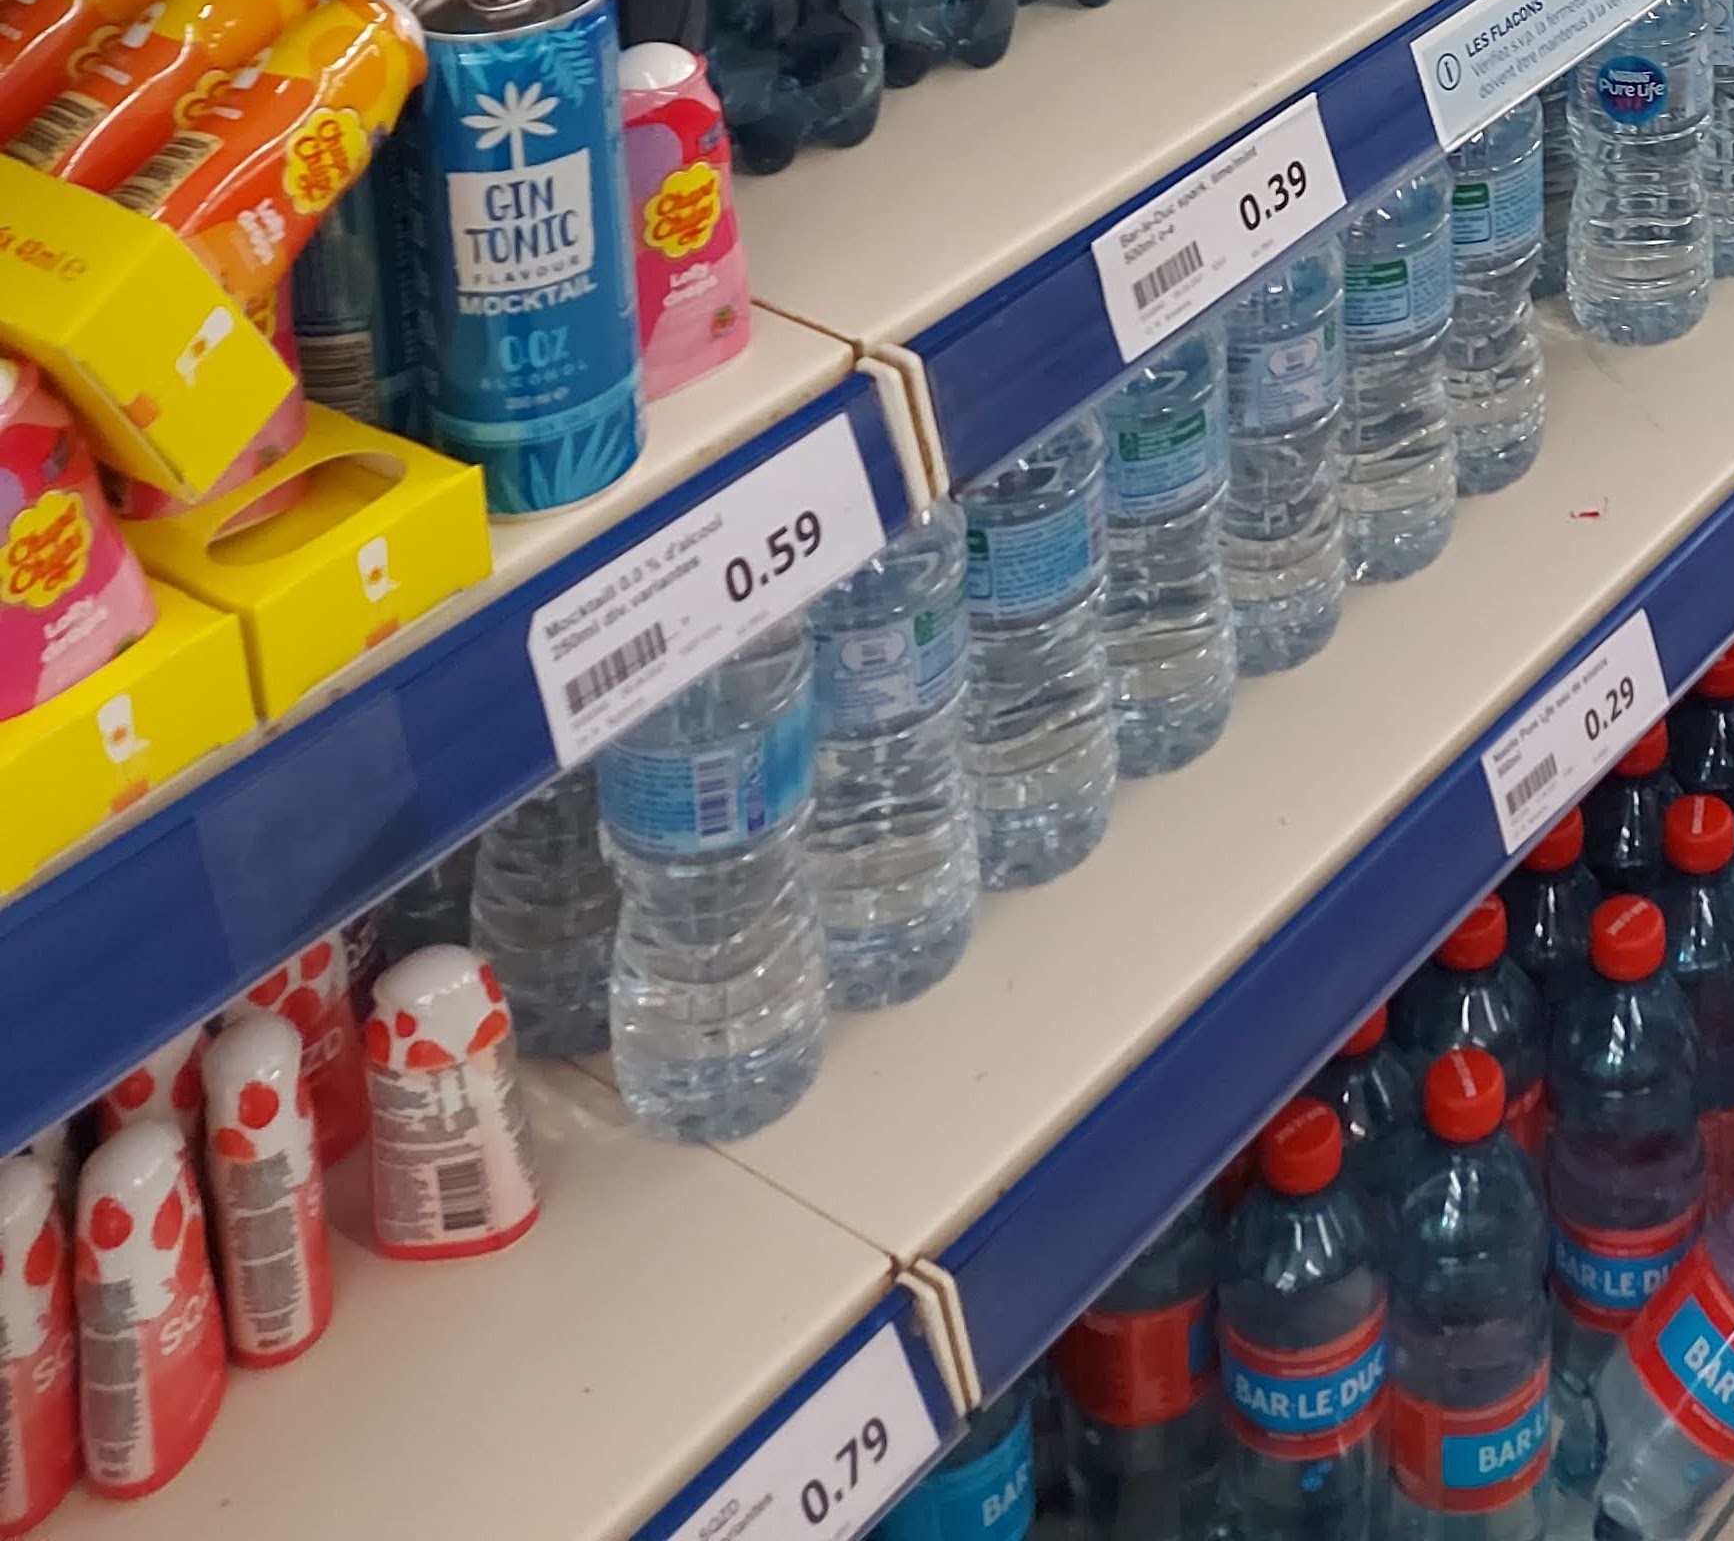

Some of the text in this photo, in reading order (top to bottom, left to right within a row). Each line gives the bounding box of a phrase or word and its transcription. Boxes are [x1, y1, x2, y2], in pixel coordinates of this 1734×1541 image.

[1466, 33, 1490, 58] LES
[1600, 80, 1666, 105] Pure Life
[485, 179, 554, 222] GIN
[1239, 160, 1307, 231] 0.39
[465, 211, 578, 267] TONIC
[459, 274, 596, 317] MOCKTAIL
[473, 255, 580, 286] FLAVOUR
[543, 587, 617, 640] Mocktail
[664, 512, 724, 563] d'alcool
[725, 509, 822, 603] 0.59
[551, 623, 604, 662] 250ml
[629, 554, 702, 615] variantes
[1584, 676, 1636, 742] 0.29
[800, 1416, 891, 1527] 0.79
